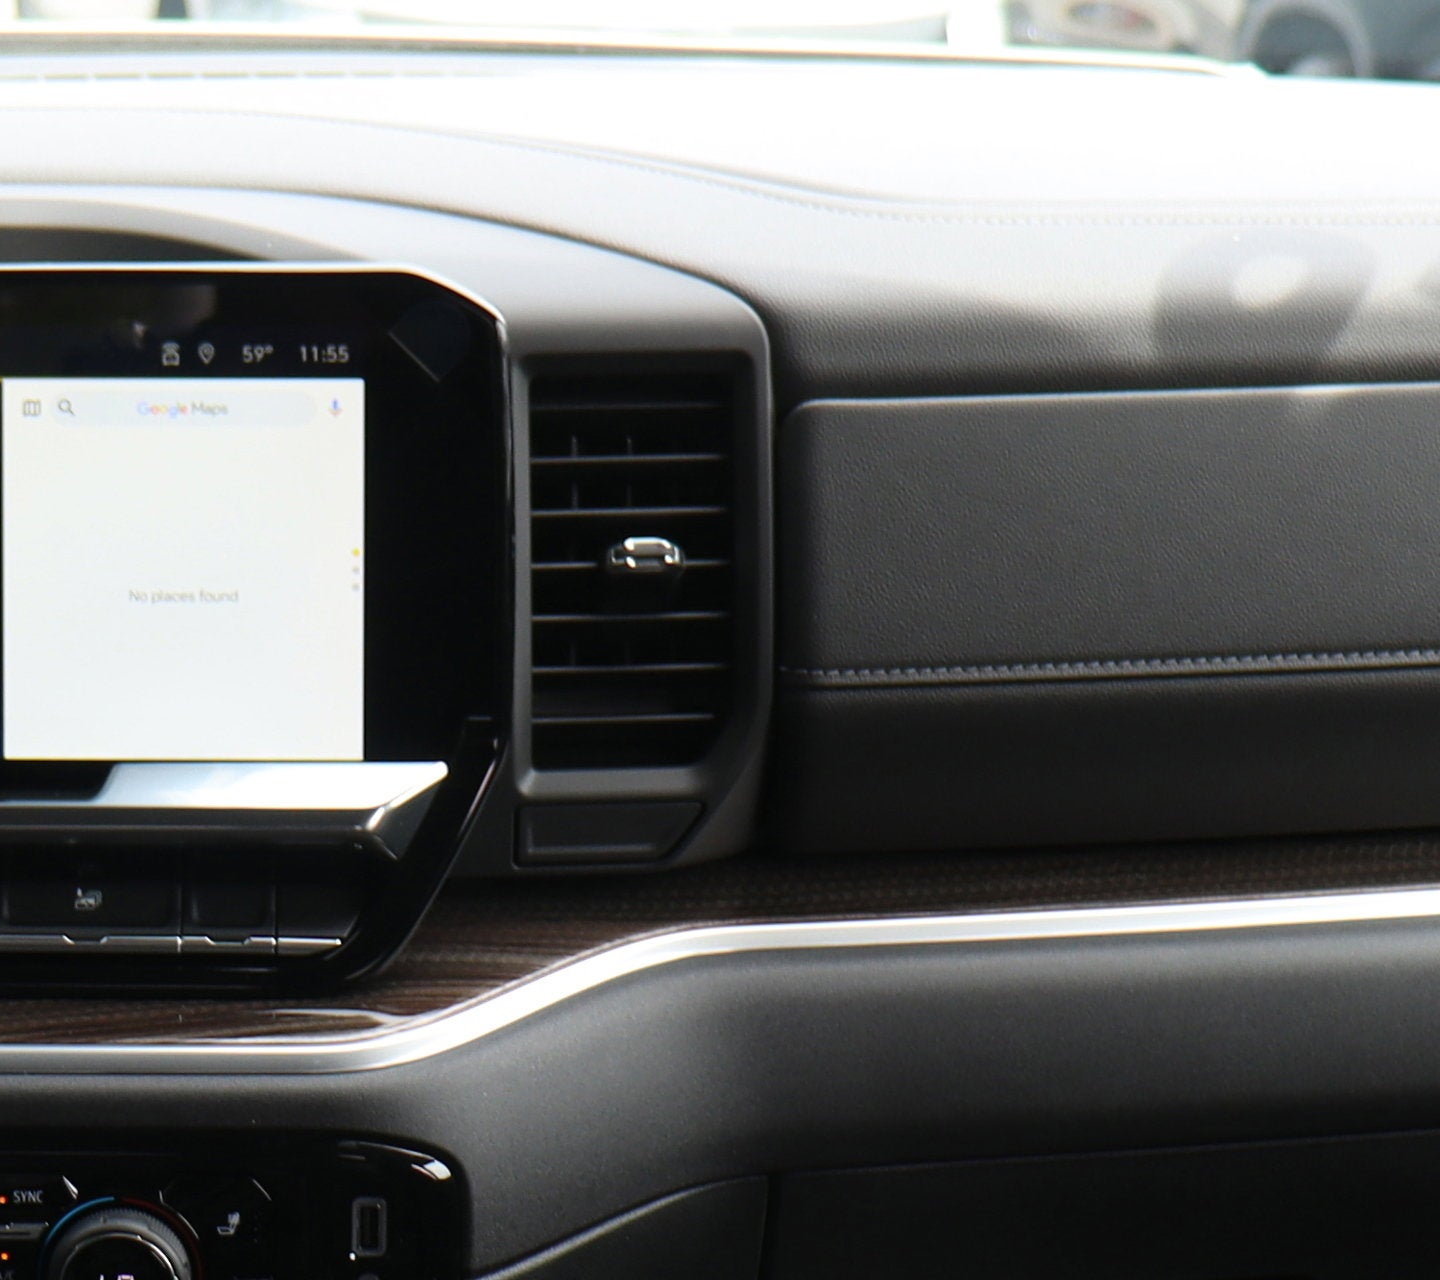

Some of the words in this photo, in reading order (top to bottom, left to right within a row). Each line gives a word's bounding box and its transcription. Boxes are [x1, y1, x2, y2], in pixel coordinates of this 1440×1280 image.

[242, 344, 273, 363] 59°
[300, 344, 349, 363] 11:55
[137, 400, 188, 418] Google
[192, 401, 228, 416] Maps
[12, 1191, 44, 1204] SYNC
